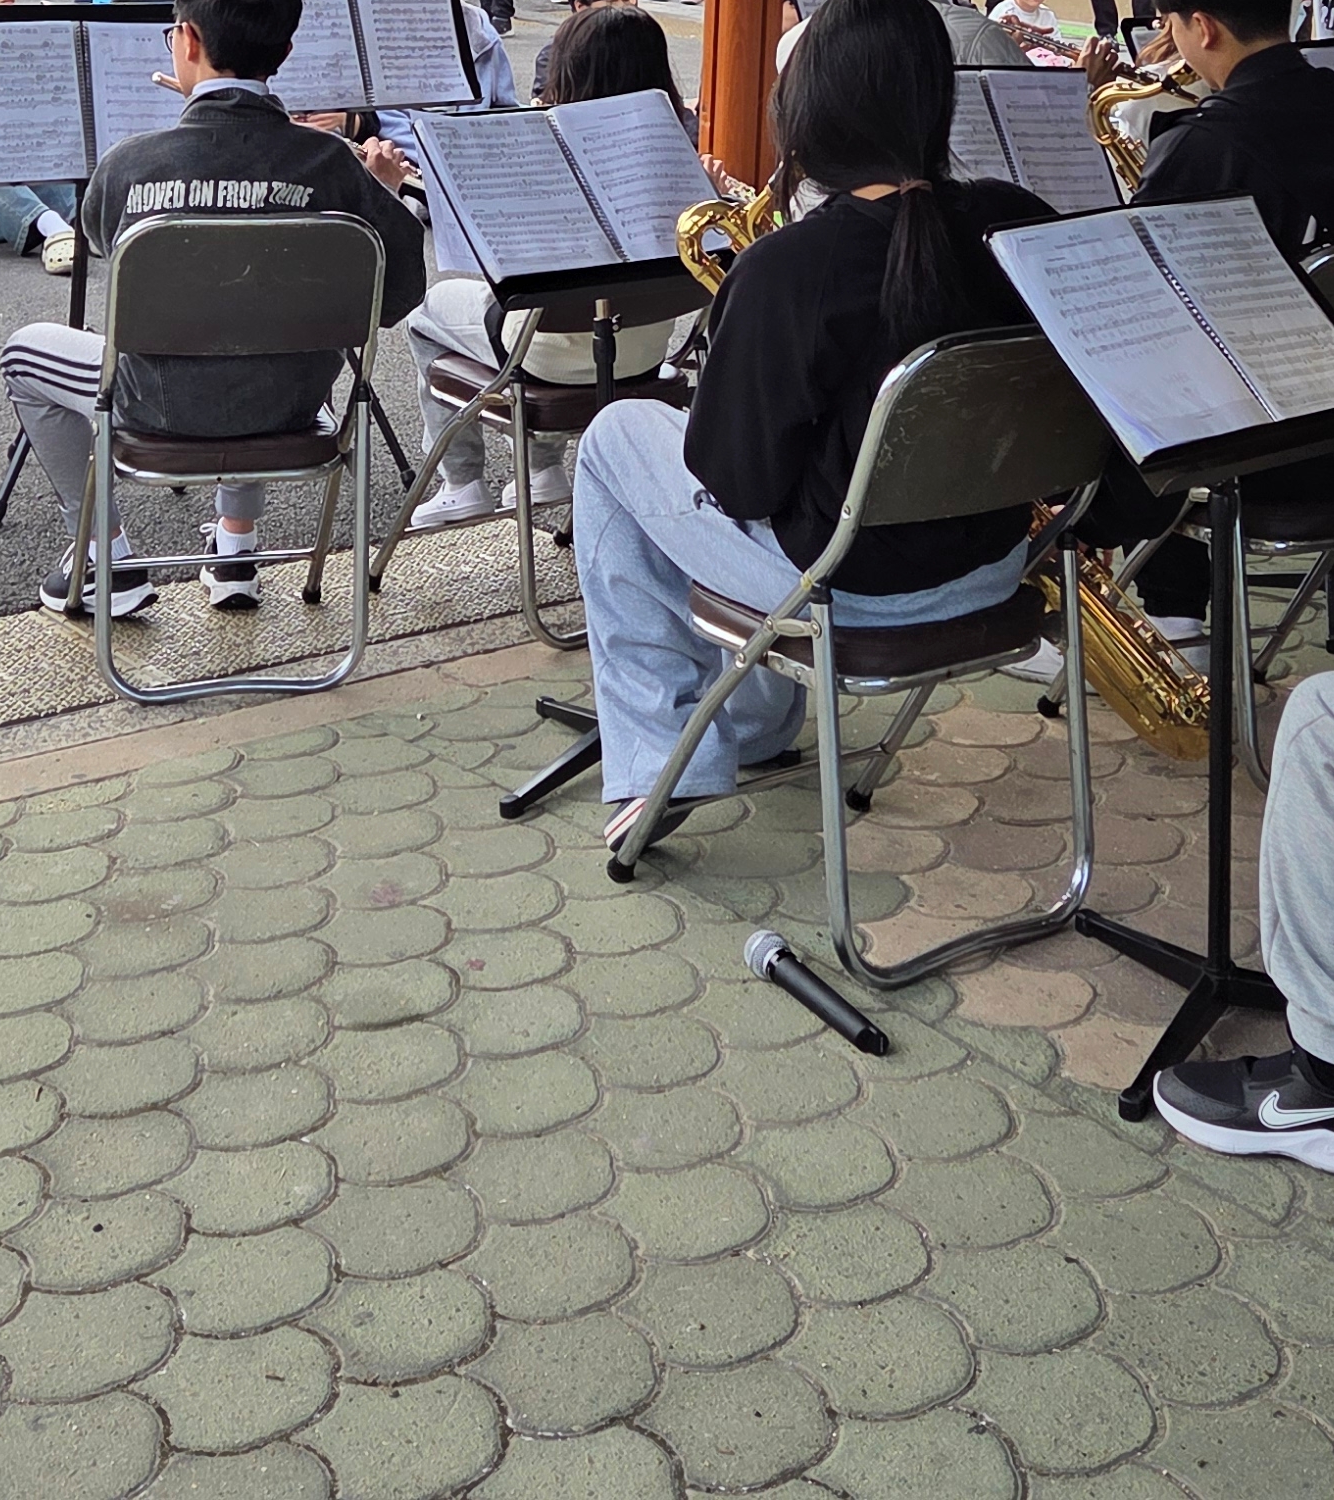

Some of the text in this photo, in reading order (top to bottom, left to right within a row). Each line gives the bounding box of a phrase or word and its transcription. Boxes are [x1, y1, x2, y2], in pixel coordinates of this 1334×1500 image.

[126, 179, 185, 214] MOVED
[188, 178, 215, 208] ON
[217, 179, 269, 209] FROM
